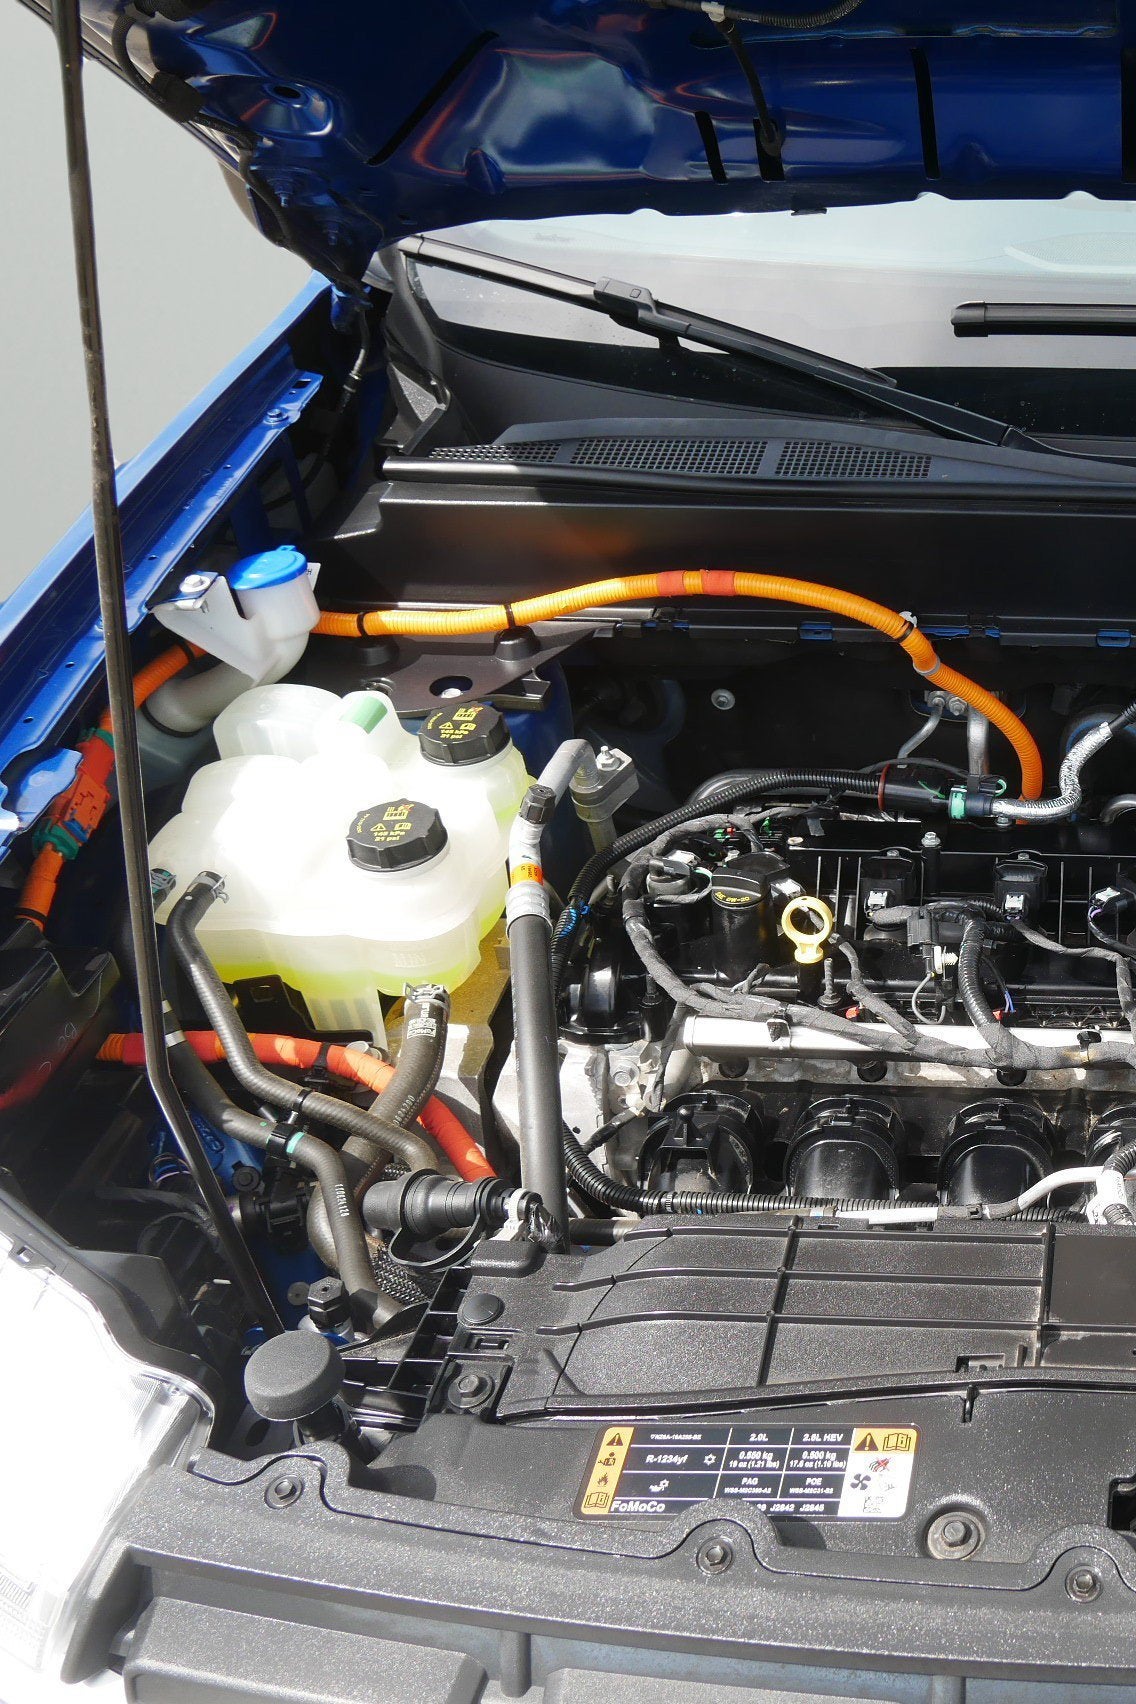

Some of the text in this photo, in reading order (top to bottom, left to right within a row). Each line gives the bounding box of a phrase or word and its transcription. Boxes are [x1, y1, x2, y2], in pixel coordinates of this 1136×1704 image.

[749, 1433, 769, 1442] 2.0L
[823, 1433, 844, 1442] HEV
[645, 1454, 689, 1465] R-1234yf
[762, 1451, 773, 1461] kg
[825, 1451, 837, 1461] kg
[805, 1477, 823, 1485] POE
[610, 1501, 666, 1513] FoMoCo
